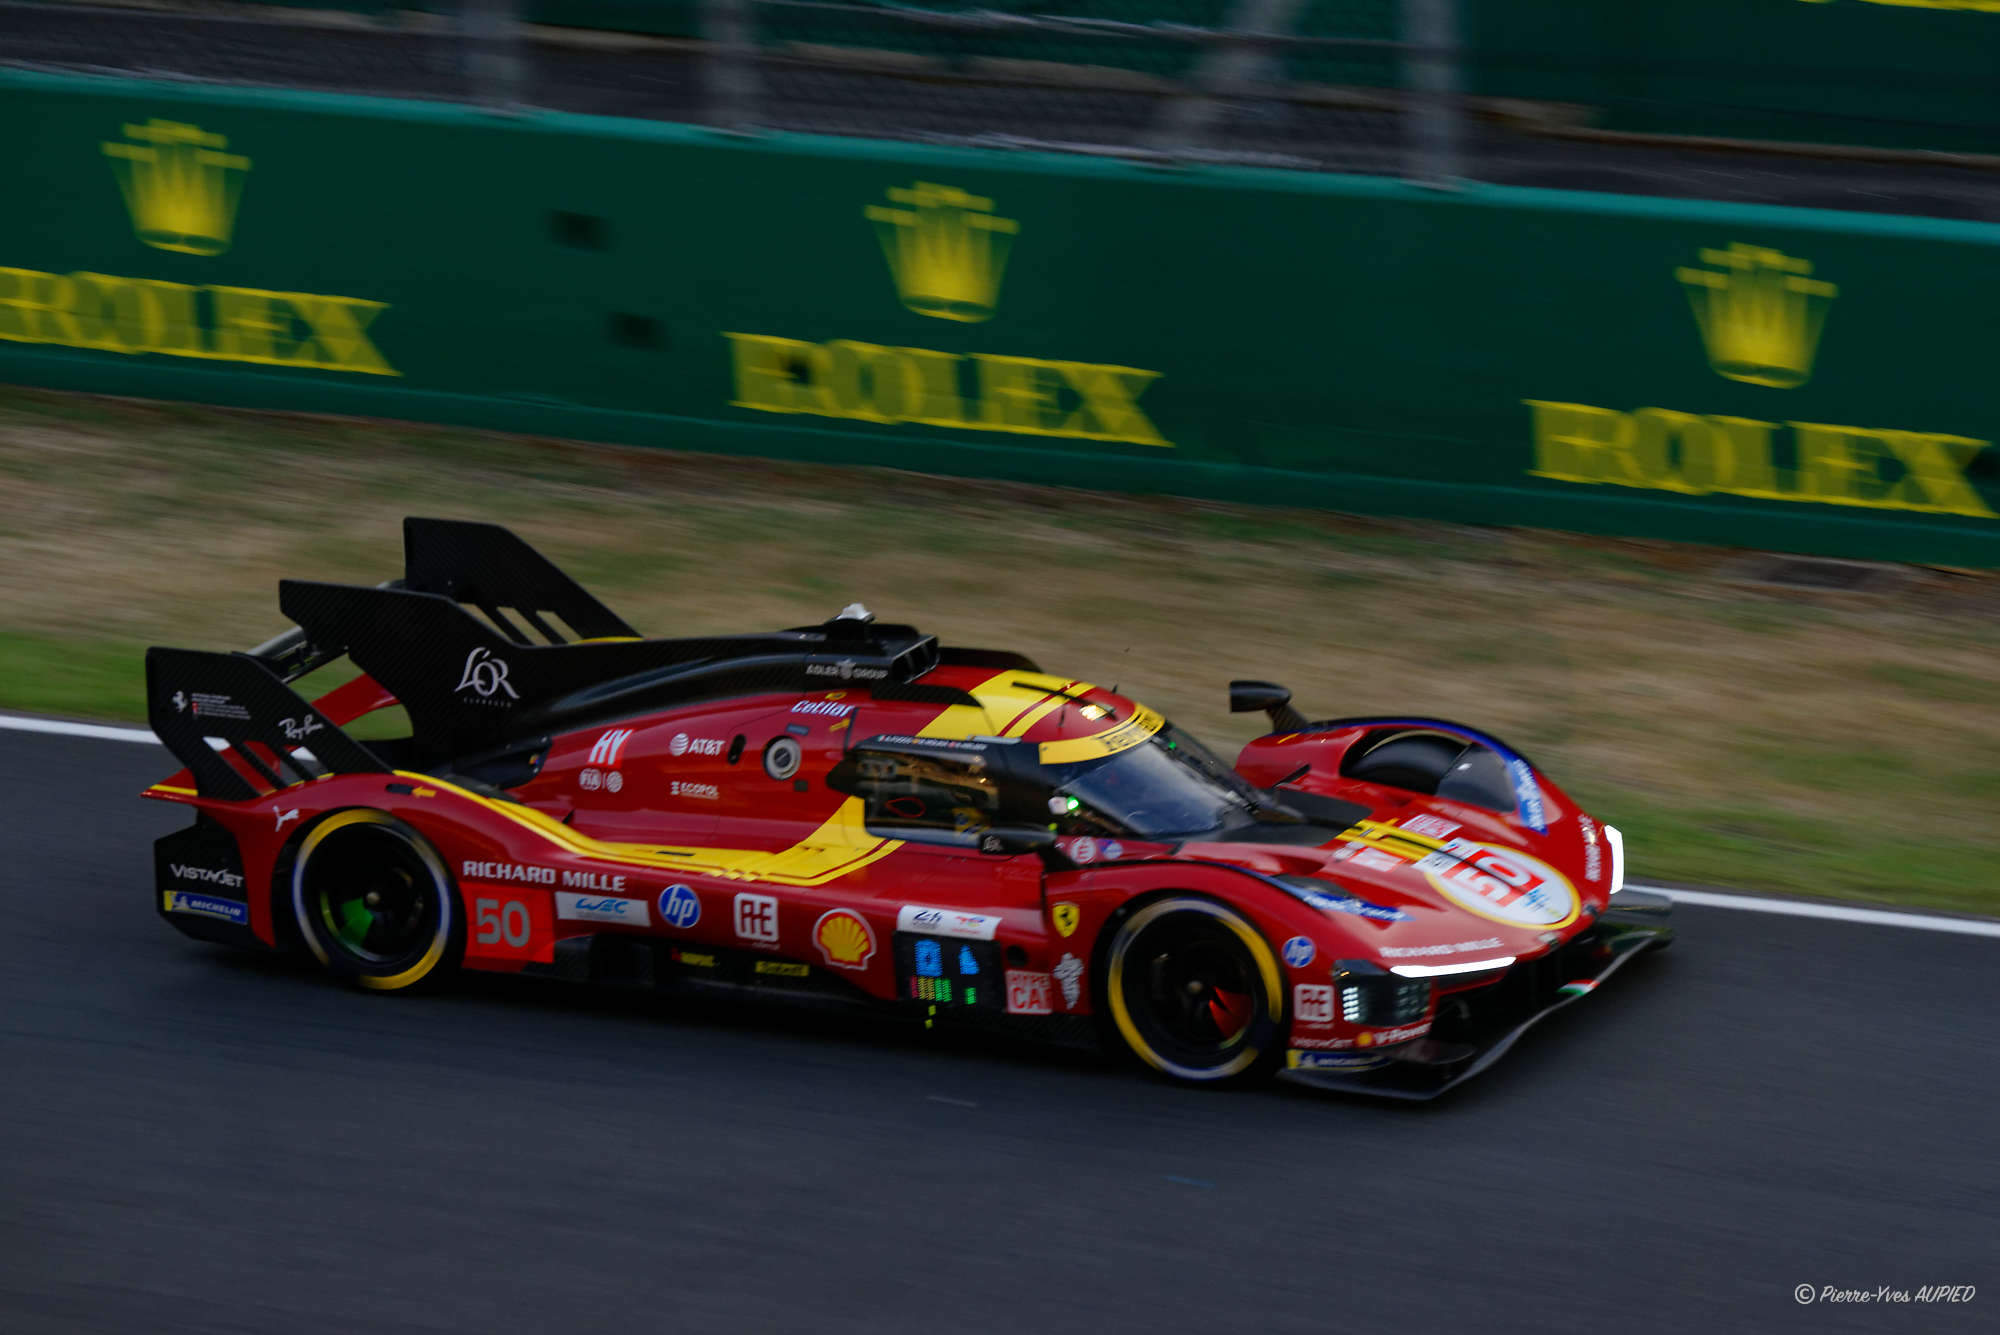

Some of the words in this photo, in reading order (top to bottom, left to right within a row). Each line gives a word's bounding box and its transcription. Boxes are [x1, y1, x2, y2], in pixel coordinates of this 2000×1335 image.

[720, 331, 1177, 448] ROLEX
[1520, 398, 2000, 519] ROLEX
[688, 738, 726, 756] AT&T
[463, 861, 556, 884] RICHARD
[562, 870, 626, 893] MILLE
[190, 900, 241, 917] MICHELIN
[475, 898, 531, 948] 50
[664, 884, 696, 929] hp
